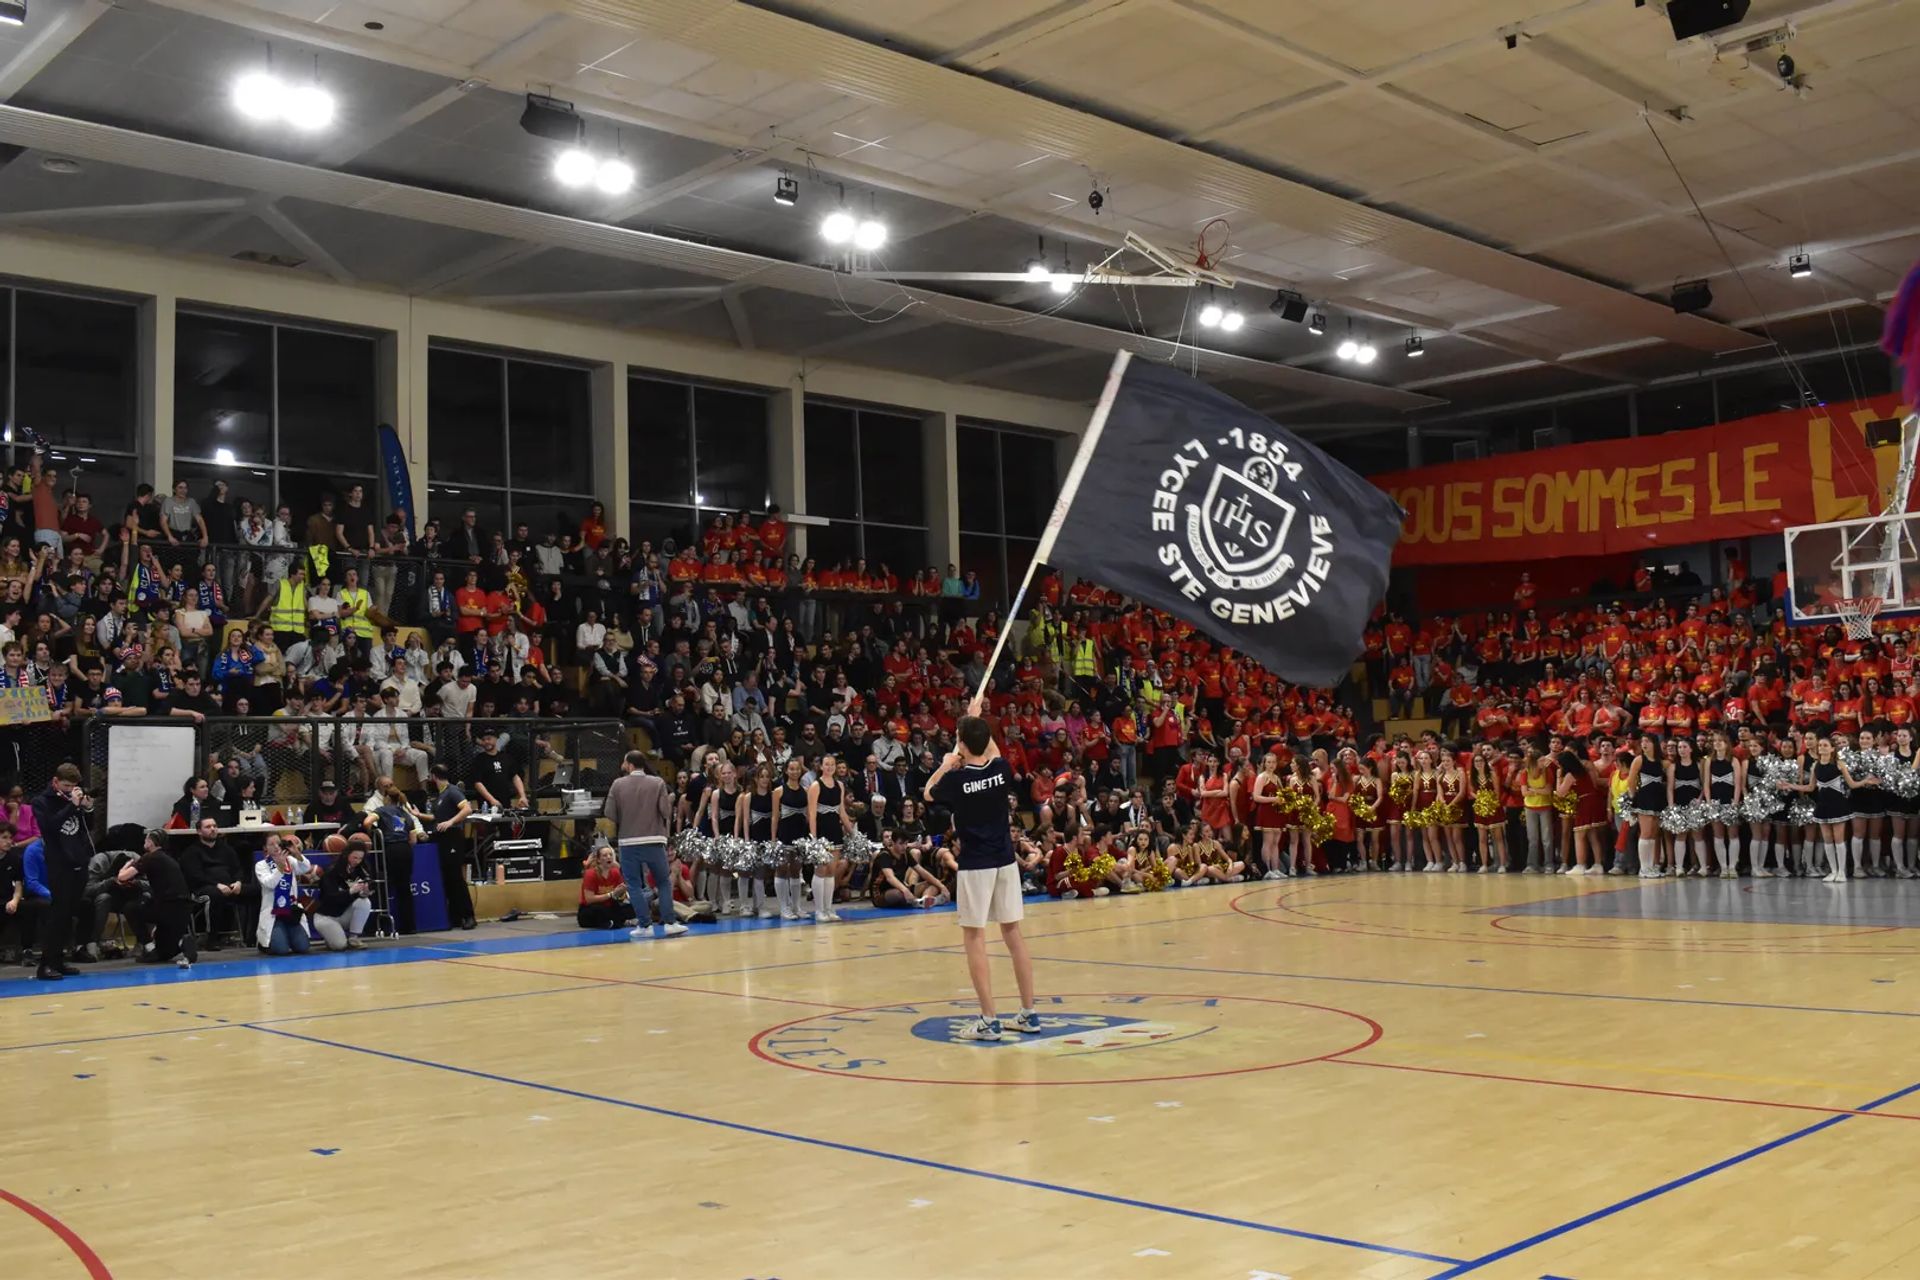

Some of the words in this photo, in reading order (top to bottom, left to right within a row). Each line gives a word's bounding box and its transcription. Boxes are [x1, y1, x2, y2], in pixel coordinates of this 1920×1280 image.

[1152, 438, 1210, 532] LYCEE
[1390, 482, 1482, 544] OUS
[1492, 458, 1696, 538] SOMMES
[1708, 442, 1781, 515] LE
[1158, 542, 1207, 602] STE
[1210, 514, 1335, 625] GENEVIEVE
[963, 773, 1006, 794] GINETTE
